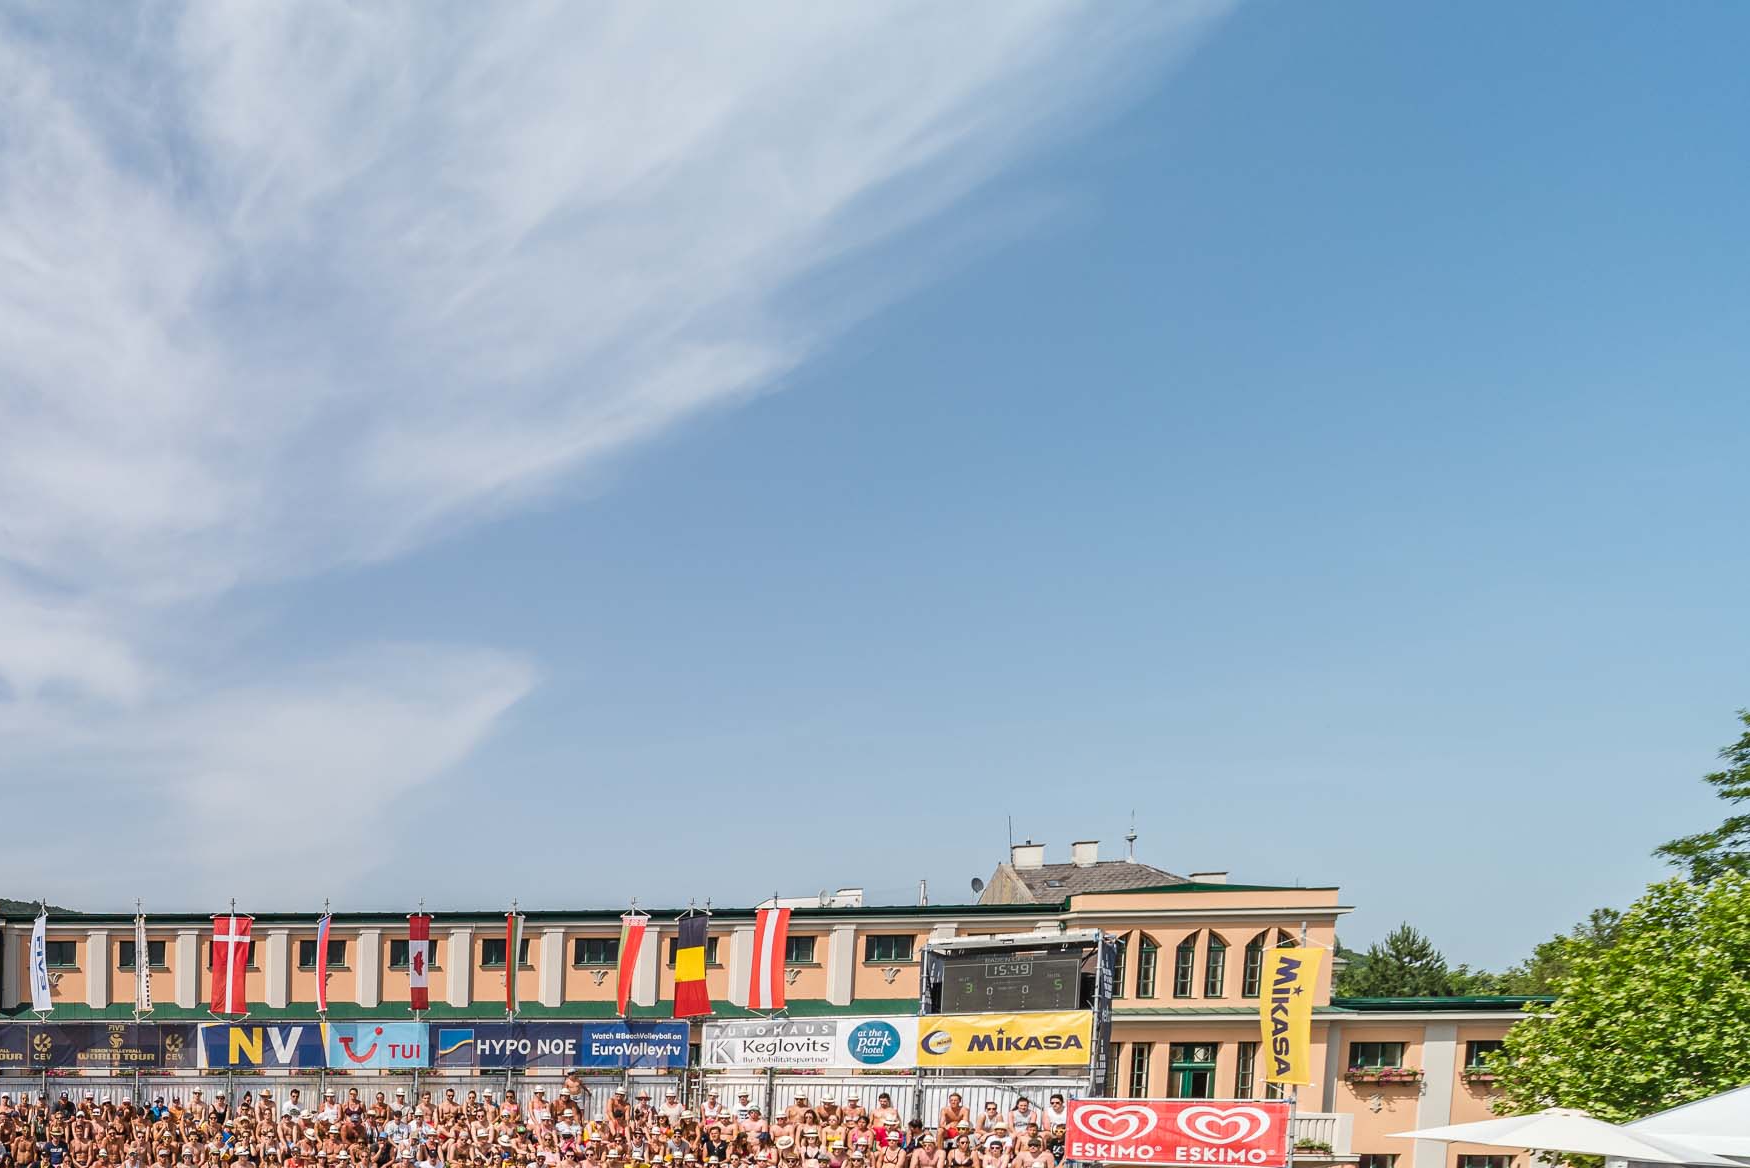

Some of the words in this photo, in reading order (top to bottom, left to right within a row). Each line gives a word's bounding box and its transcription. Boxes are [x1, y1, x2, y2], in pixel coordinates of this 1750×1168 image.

[591, 1032, 614, 1040] Watch
[615, 1032, 672, 1041] #BeachVolleyball
[713, 1025, 829, 1037] AUTOHAUS
[869, 1028, 882, 1037] the
[229, 1027, 304, 1064] NV
[477, 1039, 530, 1055] HYPO
[537, 1039, 576, 1055] NOE
[743, 1038, 830, 1055] Keglovits
[858, 1031, 891, 1052] park
[77, 1053, 115, 1061] WORLD
[117, 1053, 155, 1061] TOUR
[388, 1044, 420, 1059] TUI
[591, 1042, 681, 1058] EuroVolley.tv
[862, 1046, 884, 1054] hotel
